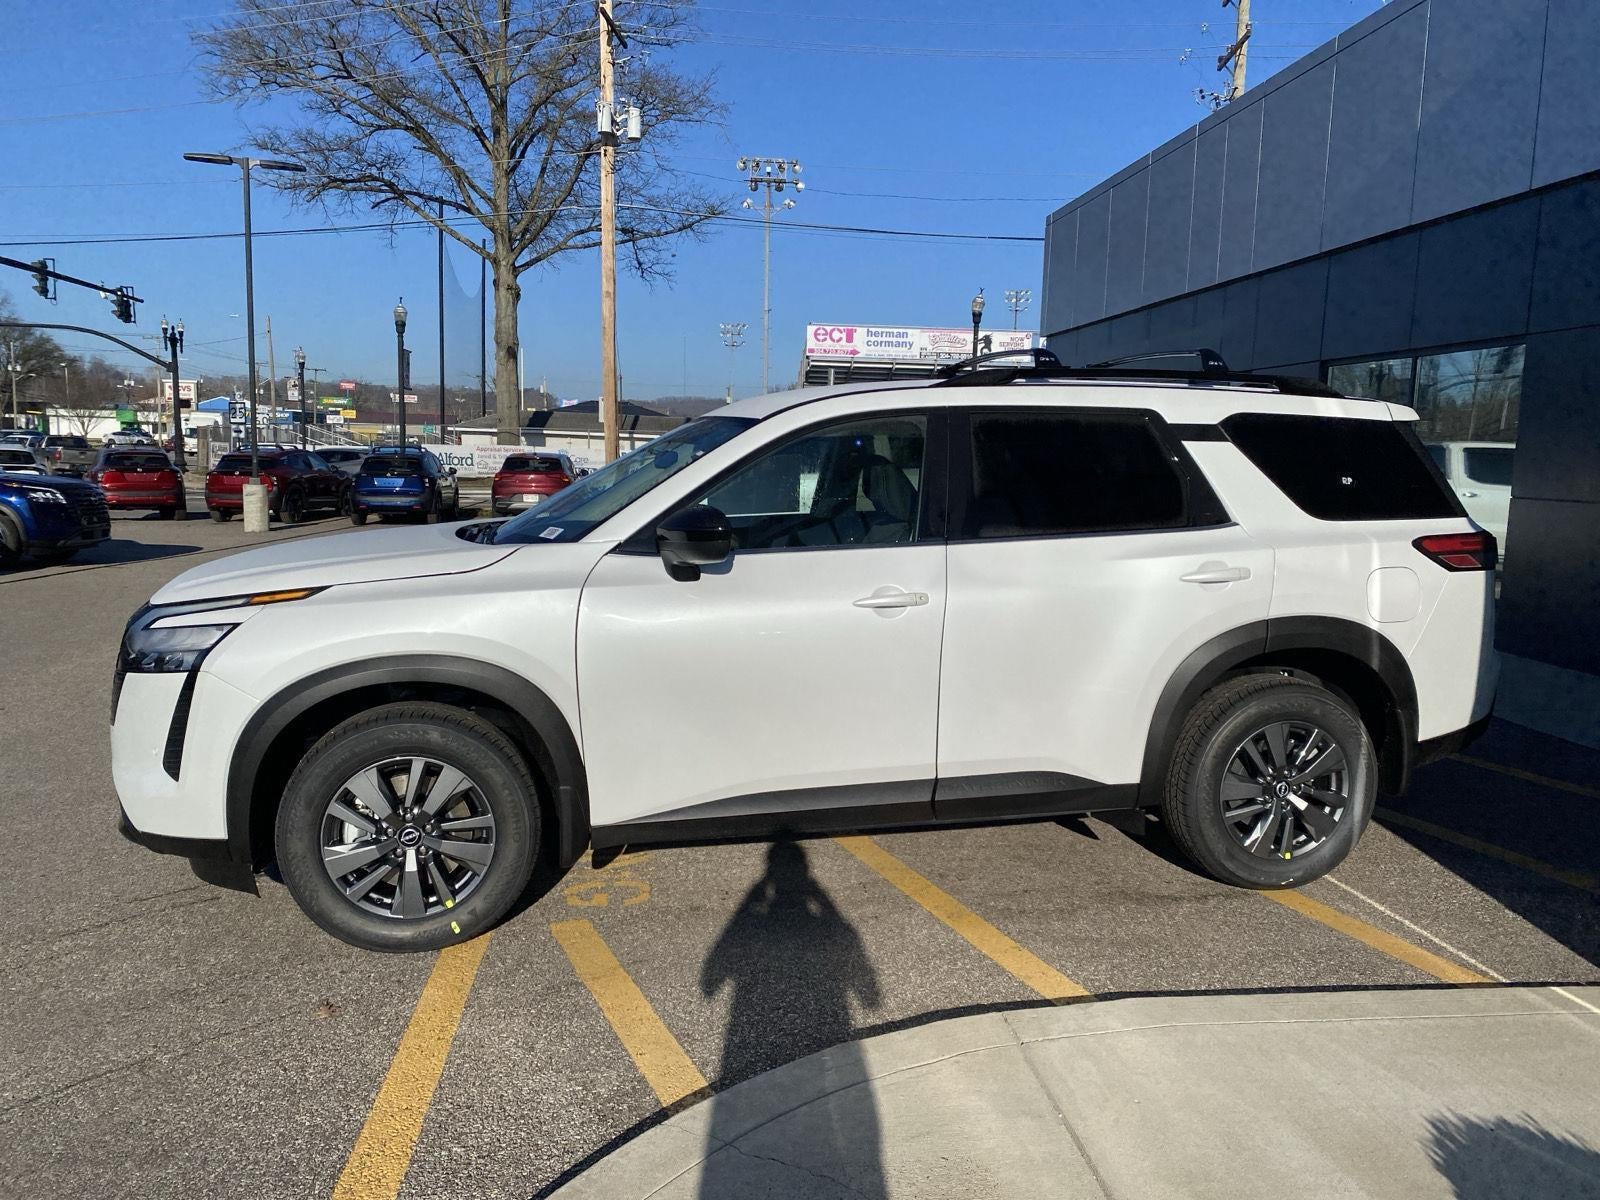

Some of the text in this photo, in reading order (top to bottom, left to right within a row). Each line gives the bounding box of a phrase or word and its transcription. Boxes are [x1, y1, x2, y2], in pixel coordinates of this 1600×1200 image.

[866, 328, 909, 339] herman
[866, 339, 914, 350] cormany
[230, 407, 244, 419] 25
[437, 452, 475, 467] Alford
